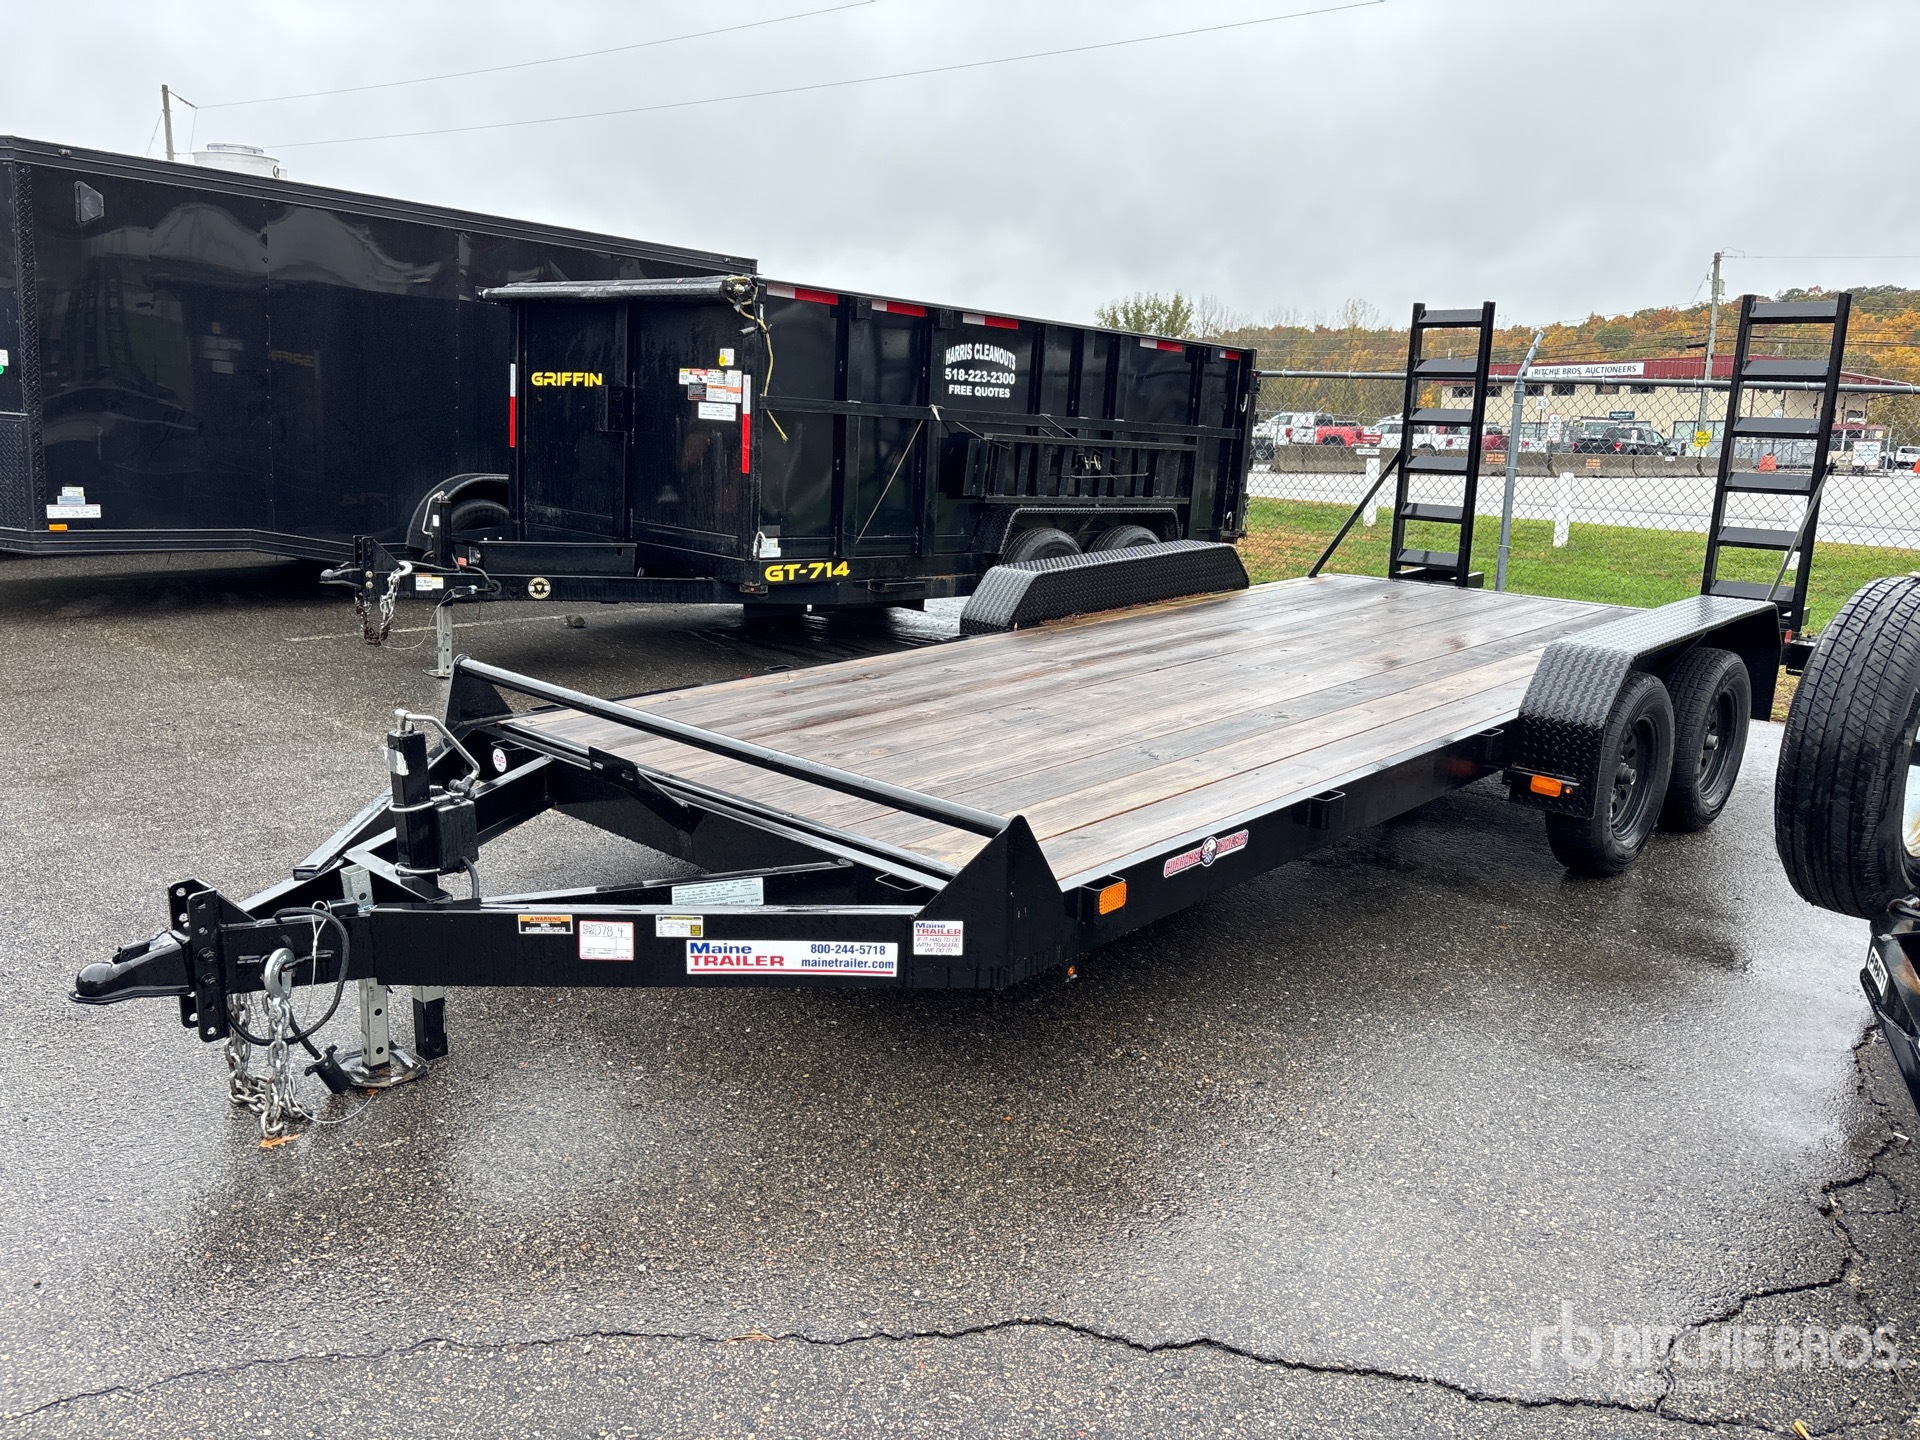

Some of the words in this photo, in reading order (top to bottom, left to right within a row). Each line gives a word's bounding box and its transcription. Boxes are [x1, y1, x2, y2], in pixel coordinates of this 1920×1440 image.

[945, 343, 973, 366] HARRIS
[974, 343, 1016, 371] CLEANOUTS
[944, 367, 1016, 385] 518-223-2300
[1534, 367, 1561, 376] RITCHIE
[1585, 365, 1637, 375] AUCTIONEERS
[531, 371, 603, 387] GRIFFIN
[948, 384, 973, 396] FREE
[974, 386, 1011, 399] QUOTES
[764, 560, 851, 582] GT-714
[690, 942, 752, 954] Maine
[810, 943, 886, 955] 800-244-5718
[690, 955, 785, 966] TRAILER
[801, 957, 894, 969] mainetrailer.com
